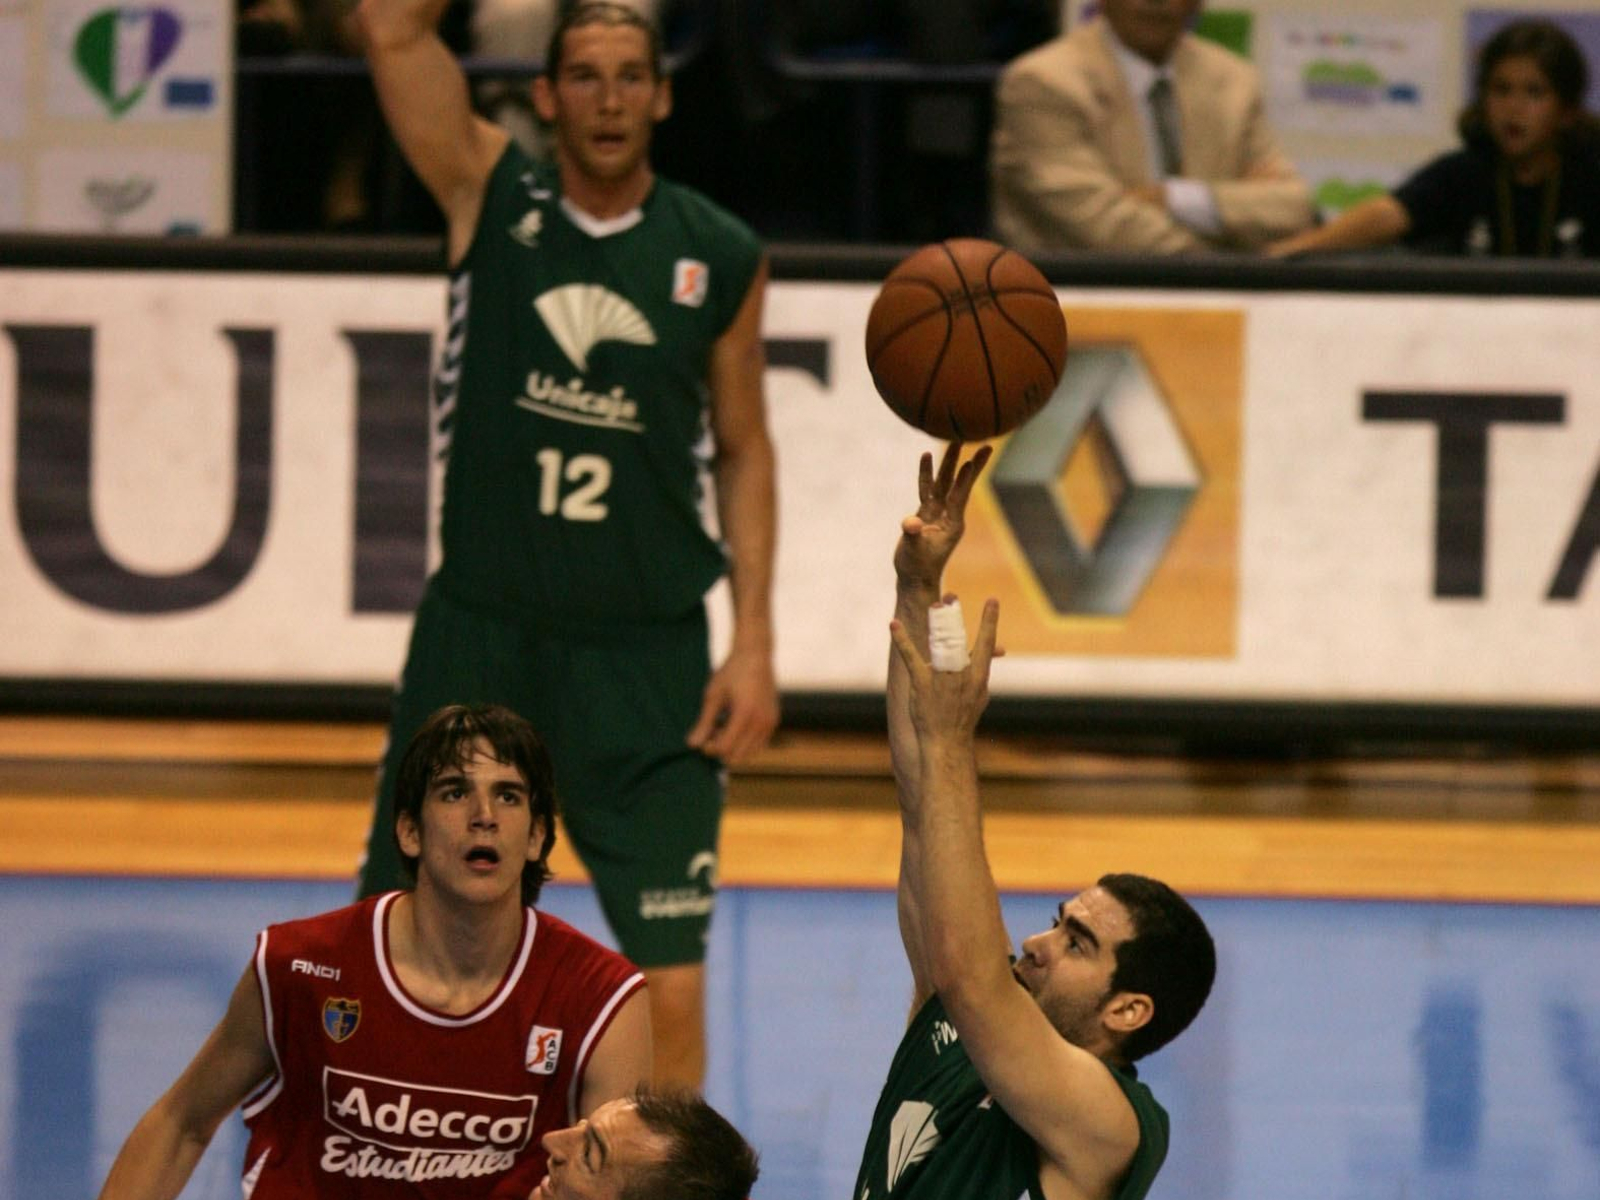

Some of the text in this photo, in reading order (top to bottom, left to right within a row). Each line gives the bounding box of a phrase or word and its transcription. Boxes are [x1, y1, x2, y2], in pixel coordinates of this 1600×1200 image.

[536, 449, 612, 520] 12
[291, 959, 341, 981] AND1
[544, 1039, 557, 1071] ACB
[332, 1087, 528, 1144] Adecco
[320, 1135, 515, 1182] Estudiantes
